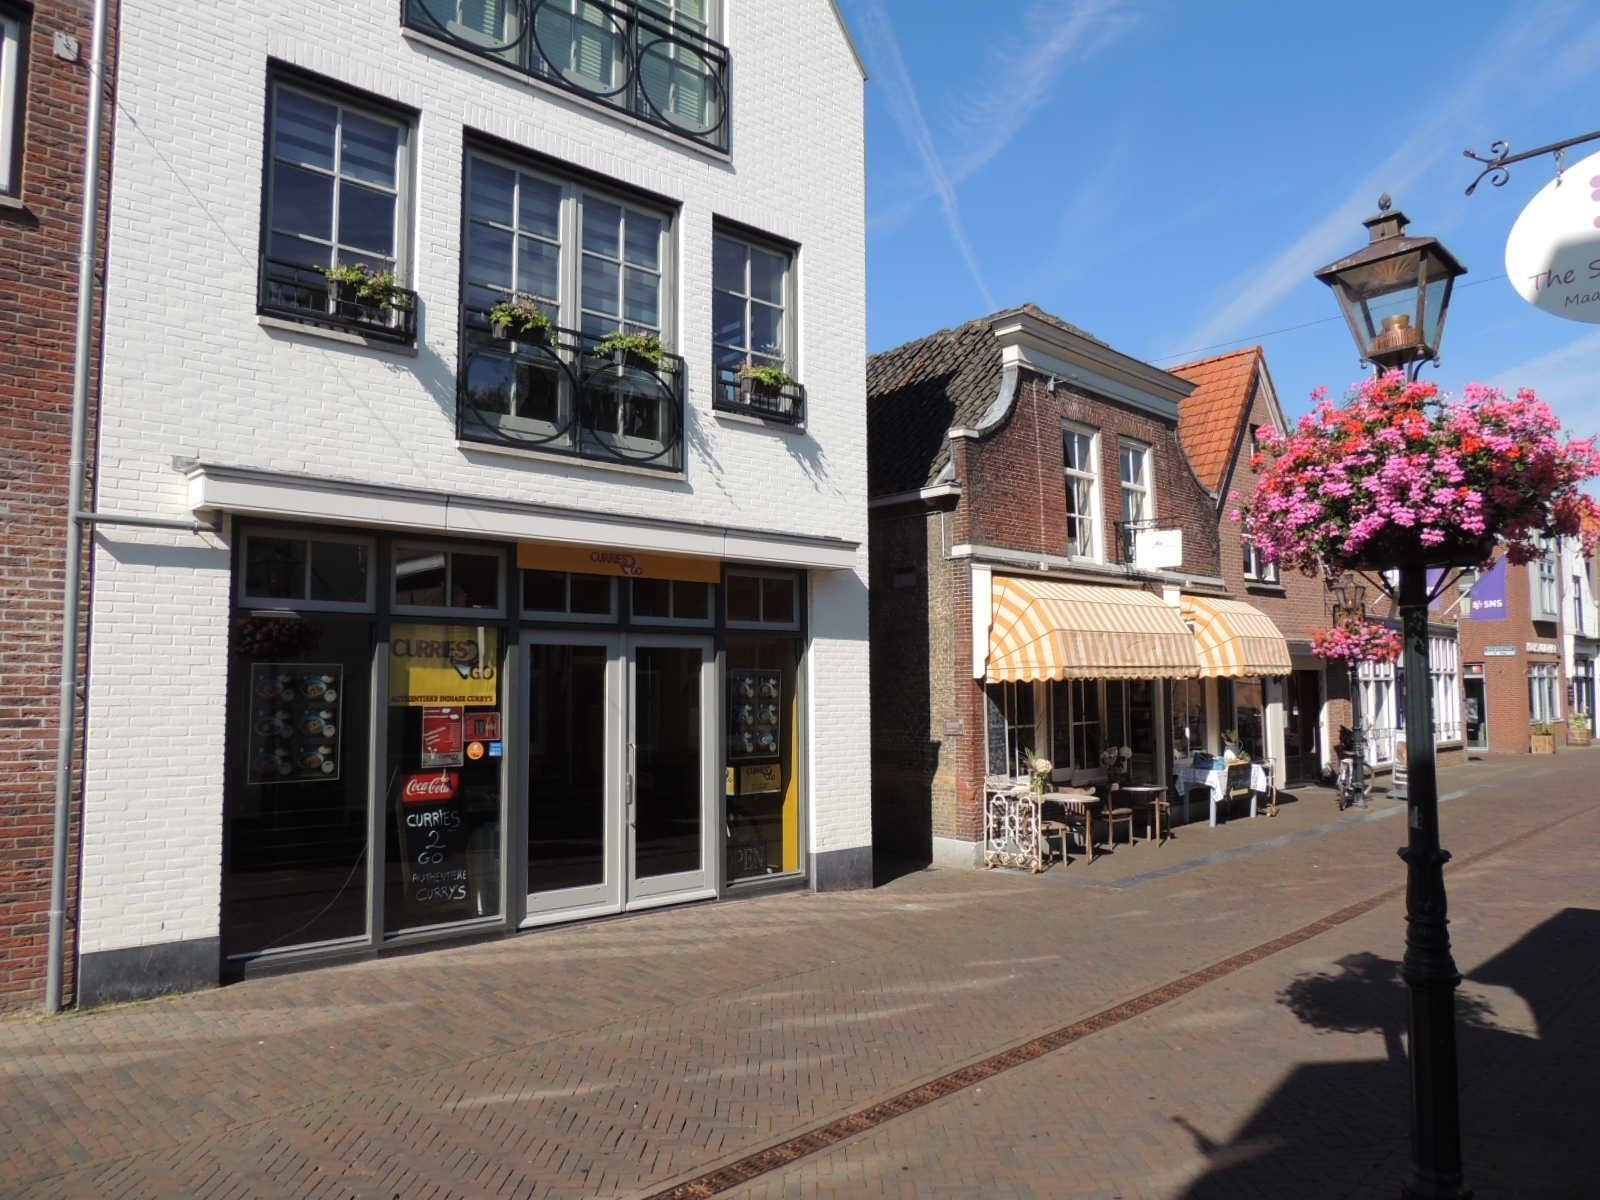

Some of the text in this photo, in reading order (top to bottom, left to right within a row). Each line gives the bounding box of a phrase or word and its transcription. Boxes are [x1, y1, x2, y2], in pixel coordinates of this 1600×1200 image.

[1528, 268, 1576, 291] The
[1483, 599, 1503, 609] SNS
[392, 639, 468, 658] CURRIES
[470, 665, 495, 681] GO
[406, 809, 461, 828] CURRIES
[425, 830, 447, 850] 2
[417, 851, 444, 865] GO
